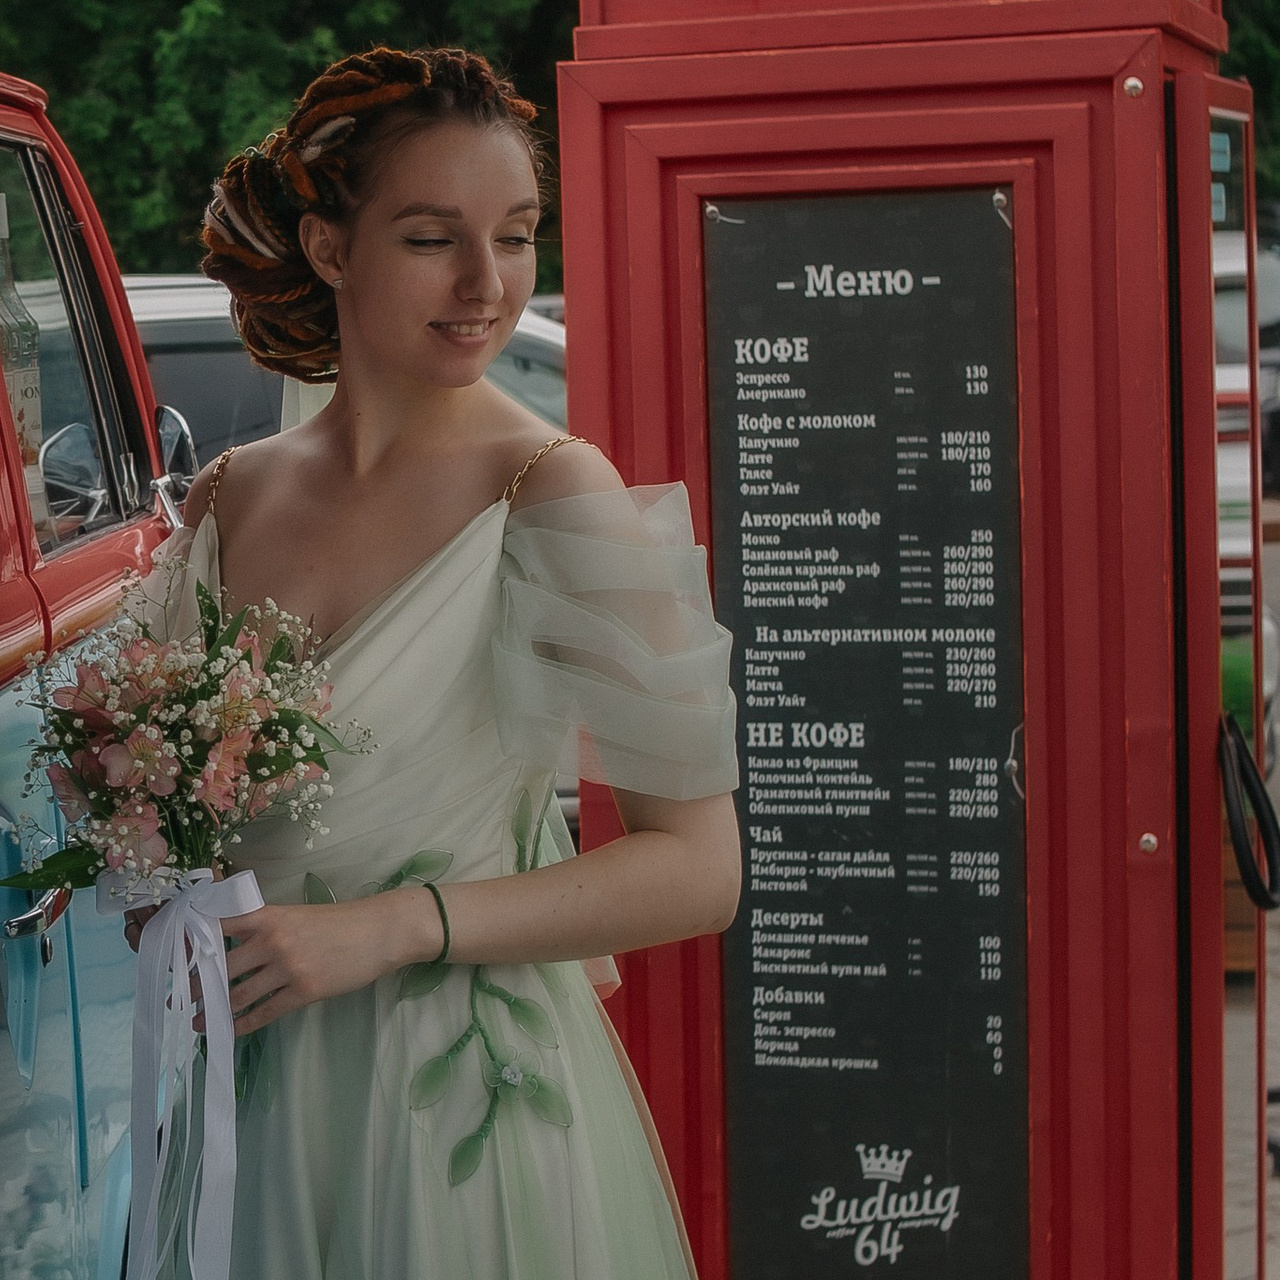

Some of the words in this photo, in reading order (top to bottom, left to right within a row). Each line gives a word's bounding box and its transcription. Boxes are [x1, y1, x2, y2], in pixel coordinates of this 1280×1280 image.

[804, 264, 914, 298] Меню
[735, 337, 808, 364] КОФЕ
[736, 372, 790, 387] Эспрессо
[966, 365, 988, 378] 130
[737, 388, 806, 402] Американо
[967, 381, 988, 394] 130
[738, 413, 782, 433] Кофе
[786, 417, 795, 429] с
[799, 415, 875, 429] молоком
[739, 437, 799, 451] Капучино
[941, 431, 990, 446] 180/210
[739, 452, 773, 464] Латте
[942, 447, 990, 463] 180/210
[740, 468, 772, 480] Глясе
[970, 463, 991, 475] 170
[740, 483, 769, 495] Флэт
[771, 482, 800, 495] Уайт
[970, 479, 991, 491] 160
[740, 509, 833, 530] Авторский
[837, 509, 880, 529] кофе
[742, 533, 780, 545] Мокко
[971, 530, 992, 542] 250
[944, 545, 993, 561] 260/290
[944, 561, 993, 576] 260/290
[945, 577, 994, 592] 260/290
[798, 594, 828, 609] кофе
[945, 593, 994, 608] 220/260
[756, 626, 778, 642] На
[783, 629, 927, 645] альтернативном
[932, 629, 995, 642] молоке
[745, 649, 805, 663] Капучино
[946, 648, 995, 662] 230/260
[746, 664, 779, 676] Латте
[946, 663, 996, 678] 230/260
[746, 679, 783, 691] Матча
[947, 679, 996, 694] 220/270
[975, 695, 996, 707] 210
[747, 723, 783, 747] НЕ
[791, 723, 864, 747] КОФЕ
[748, 756, 783, 768] Какао
[803, 756, 858, 771] Франции
[949, 758, 997, 773] 180/210
[749, 772, 813, 784] Молочный
[976, 773, 998, 786] 280
[949, 789, 998, 805] 220/260
[950, 804, 998, 820] 220/260
[749, 826, 782, 842] Чай
[950, 851, 999, 866] 220/260
[951, 867, 999, 882] 220/260
[751, 909, 823, 929] Десерты
[980, 936, 1000, 949] 100
[981, 952, 1001, 964] 110
[981, 967, 1001, 980] 110
[753, 986, 825, 1006] Добавки
[987, 1016, 1002, 1028] 20
[986, 1031, 1002, 1044] 60
[800, 1173, 960, 1232] Ludwig
[826, 1226, 857, 1239] coffee
[854, 1221, 904, 1266] 64
